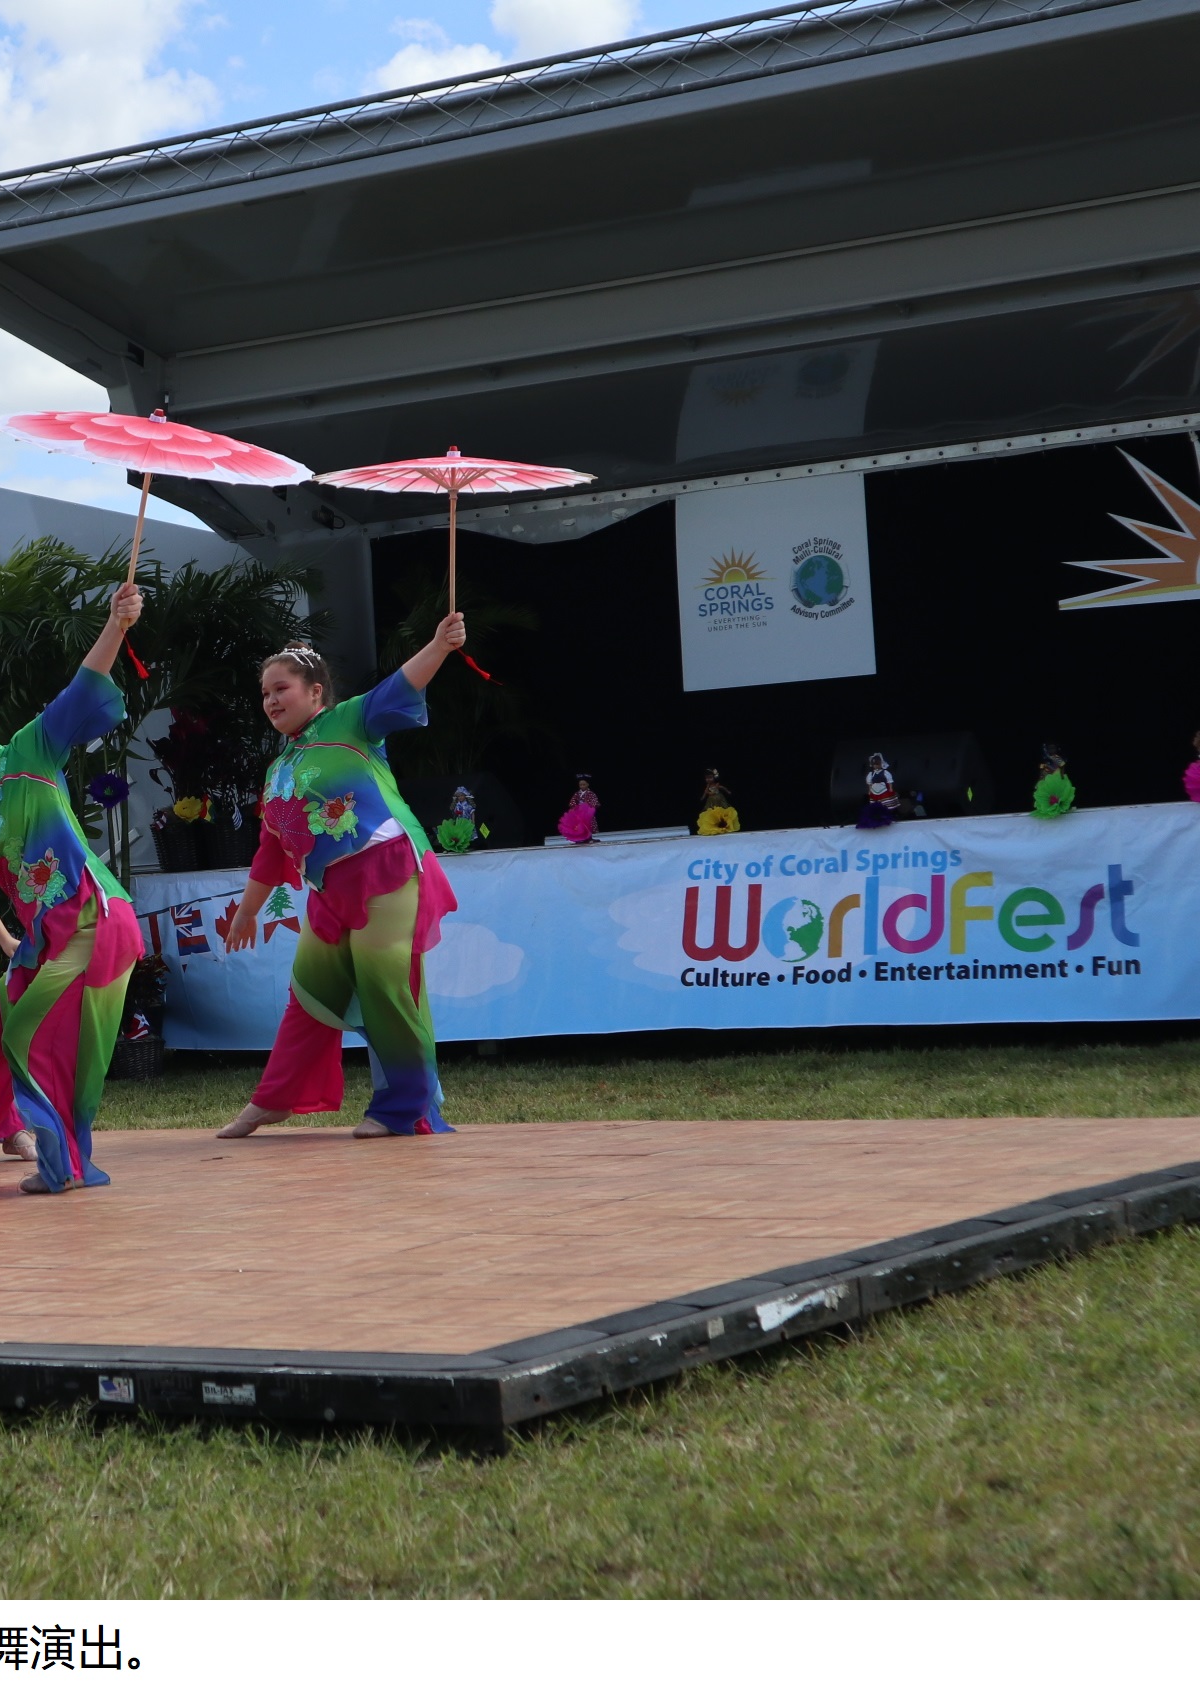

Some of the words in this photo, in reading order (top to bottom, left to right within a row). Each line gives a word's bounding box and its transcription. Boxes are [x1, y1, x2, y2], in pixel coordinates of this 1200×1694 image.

[792, 539, 812, 555] Coral
[813, 536, 842, 551] Springs
[792, 545, 843, 565] Multi-Cultural
[704, 582, 766, 601] CORAL
[698, 596, 774, 617] SPRINGS
[790, 604, 819, 620] Advisory
[820, 597, 855, 619] Committee
[707, 624, 733, 632] UNDER
[735, 622, 750, 630] THE
[752, 620, 768, 628] SUN
[713, 614, 761, 625] EVERYTHING
[687, 857, 739, 885] City
[745, 854, 774, 878] of
[780, 849, 848, 877] Coral
[856, 845, 963, 876] Springs
[680, 967, 771, 988] Culture
[792, 962, 852, 985] Food
[874, 959, 1068, 982] Entertainment
[1092, 955, 1141, 976] Fun
